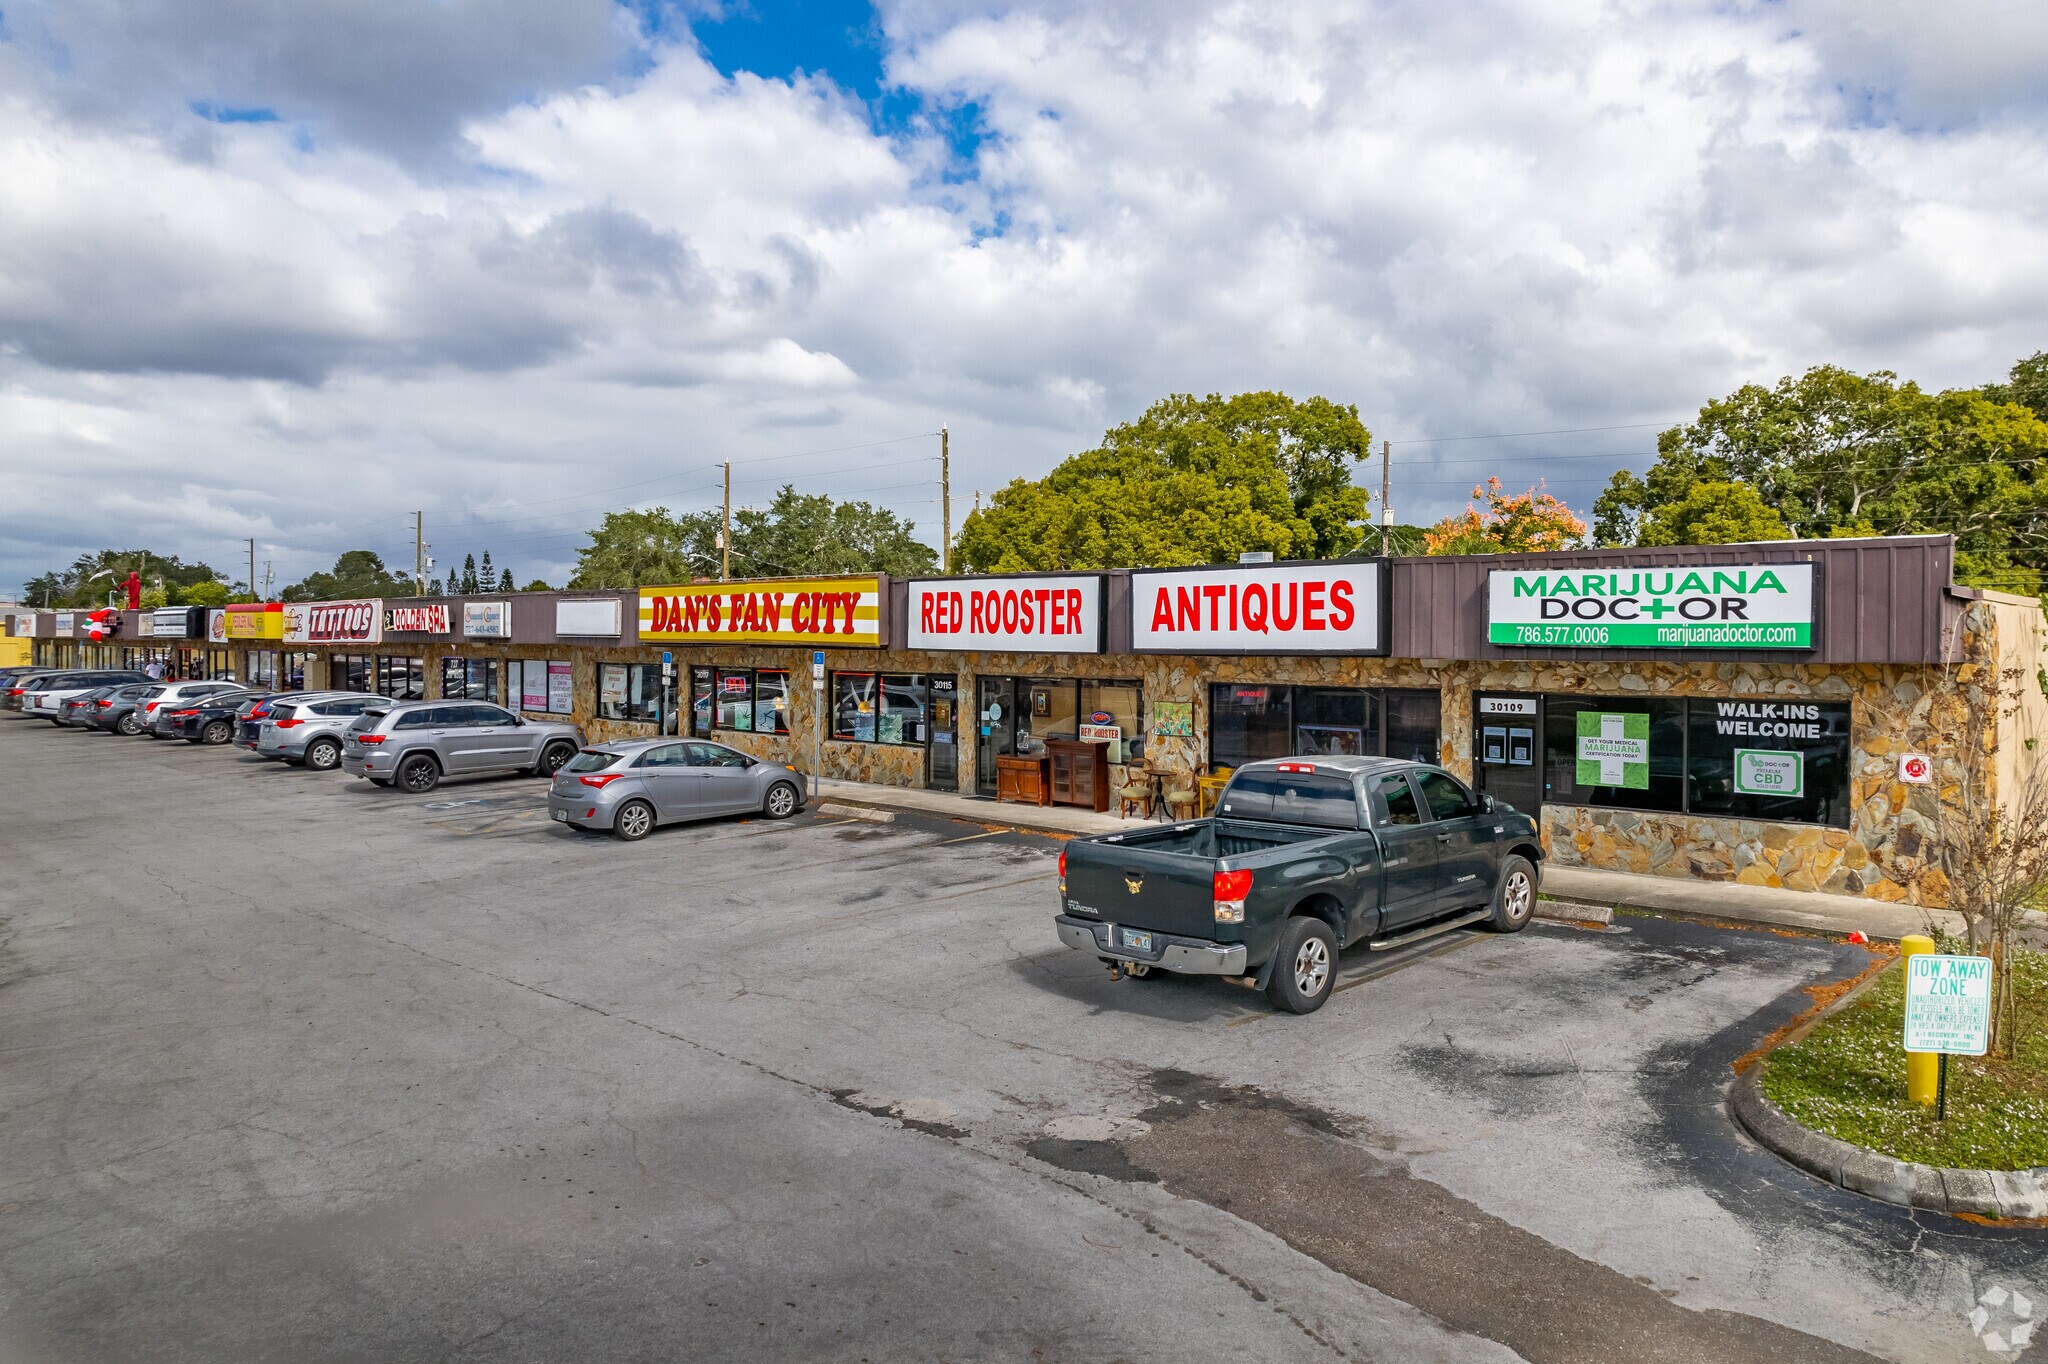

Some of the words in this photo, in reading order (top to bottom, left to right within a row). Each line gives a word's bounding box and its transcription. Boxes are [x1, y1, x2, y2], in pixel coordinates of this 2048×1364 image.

[1513, 570, 1788, 598] MARIJUANA
[651, 594, 721, 633] DAN'S
[728, 592, 784, 632] FAN
[791, 591, 861, 634] CITY
[921, 591, 963, 634] RED
[970, 588, 1083, 635] ROOSTER
[1151, 579, 1355, 635] ANTIQUES
[309, 604, 373, 640] TATTOOS
[428, 604, 446, 634] SPA
[1516, 626, 1609, 643] 786.577.0006
[1657, 624, 1796, 646] marijuanadoctor.com
[934, 680, 953, 690] 30115
[1490, 702, 1523, 712] 30109
[1718, 702, 1820, 720] WALK-INS
[1080, 727, 1091, 737] RED
[1716, 720, 1820, 738] WELCOME
[1584, 744, 1641, 753] MARIJUANA
[1754, 774, 1783, 784] CBD
[1068, 903, 1098, 914] TUNDRA
[1914, 960, 1942, 977] TOW
[1948, 962, 1986, 979] AWAY
[1930, 978, 1967, 996] ZONE
[1912, 995, 1955, 1004] UNAUTHORIZED
[1958, 997, 1985, 1006] VEHICLES
